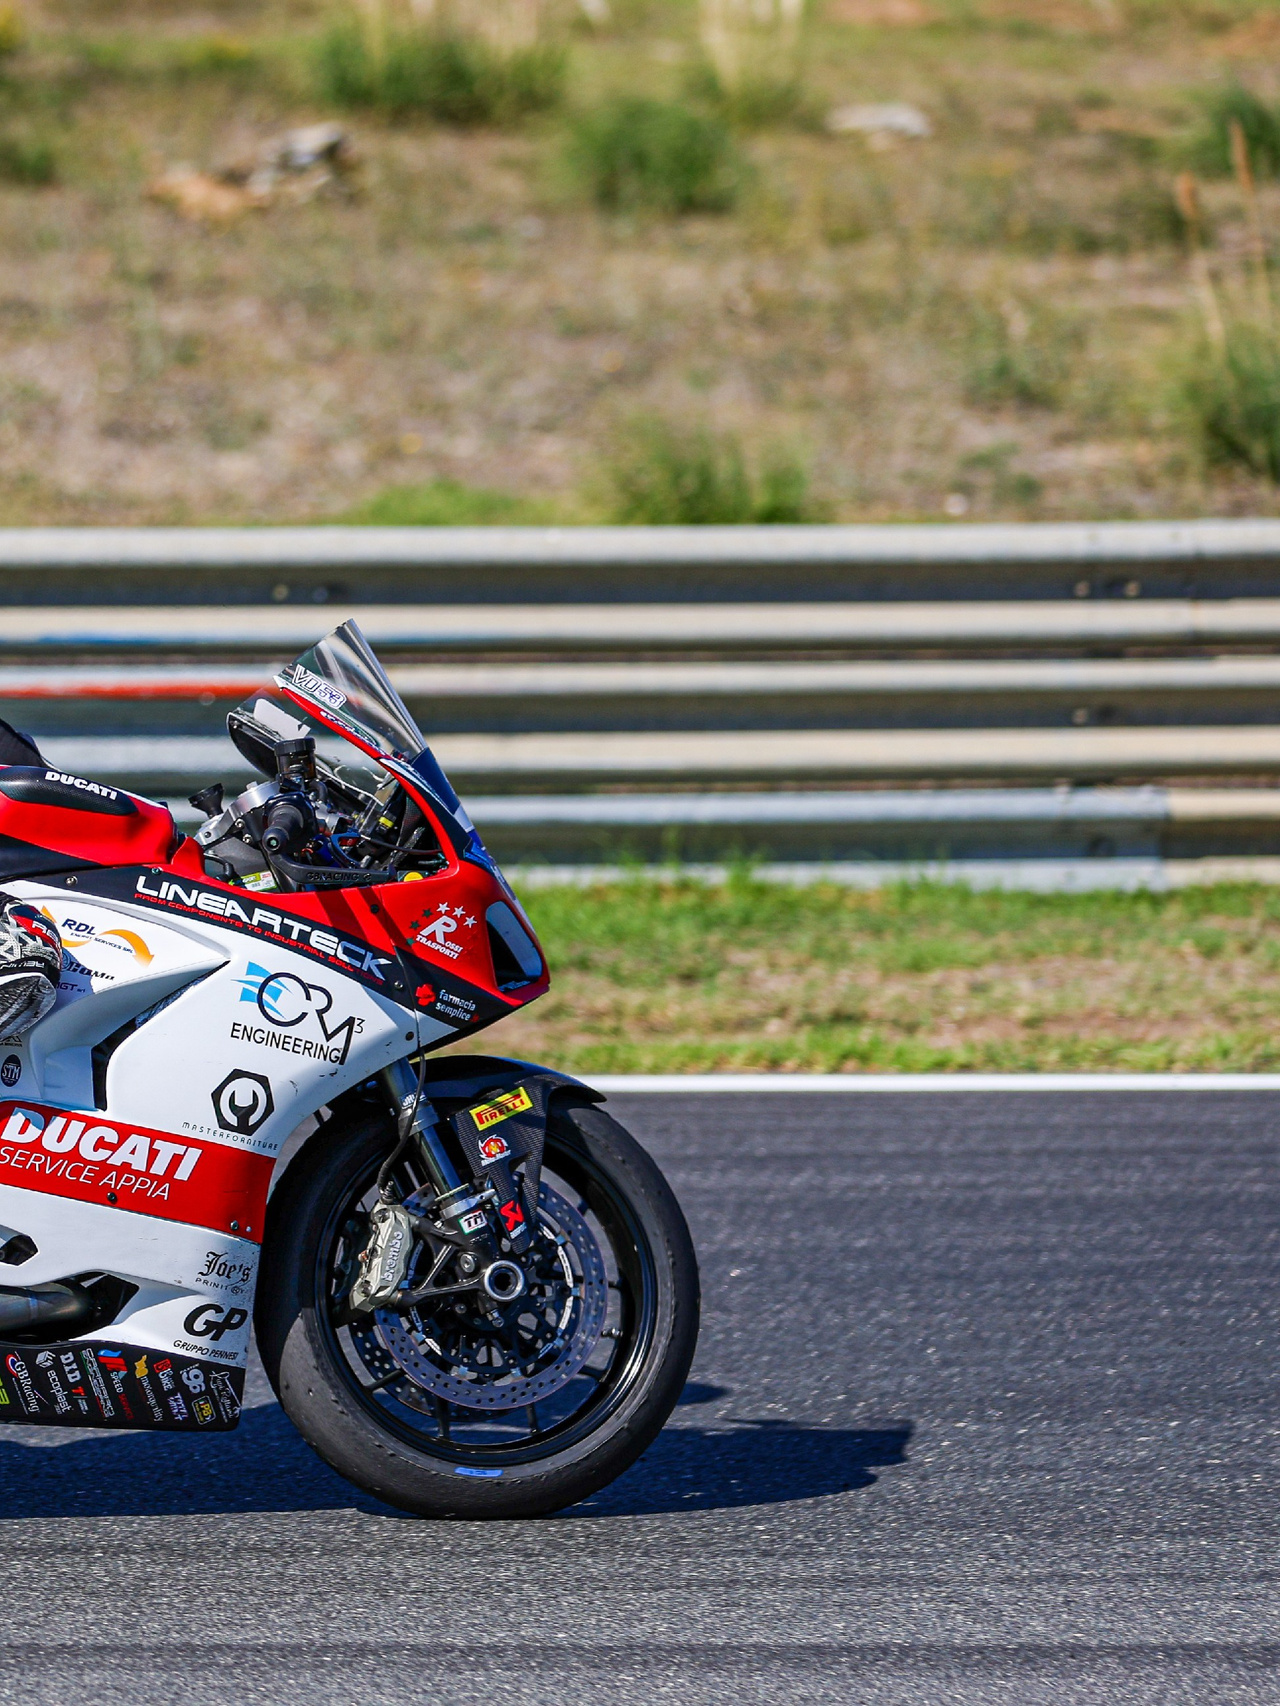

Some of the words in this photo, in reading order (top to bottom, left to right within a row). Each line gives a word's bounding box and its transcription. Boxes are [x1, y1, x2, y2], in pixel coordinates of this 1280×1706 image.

[45, 771, 117, 800] DUCATI
[61, 918, 97, 936] RDL
[134, 893, 168, 906] FROM
[168, 901, 244, 929] COMPONENTS
[247, 924, 263, 935] TO
[264, 930, 325, 959] INDUSTRIAL
[136, 875, 393, 981] LINEARTECK
[94, 937, 122, 950] SERVICES
[416, 934, 459, 960] TRASPORTI
[435, 1001, 471, 1021] semplice
[439, 989, 476, 1011] farmacia
[230, 1022, 342, 1064] ENGINEERING
[1, 1063, 21, 1078] STM
[475, 1093, 525, 1125] PIRELLI
[1, 1107, 203, 1182] DUCATI
[182, 1121, 279, 1151] MASTERFORNITURE
[99, 1170, 170, 1201] APPIA
[198, 1251, 253, 1283] Joe's
[380, 1231, 403, 1282] brembo
[183, 1303, 248, 1341] GP
[173, 1339, 209, 1356] GRUPPO
[47, 1369, 72, 1413] ecoplast
[110, 1371, 124, 1393] SPEED
